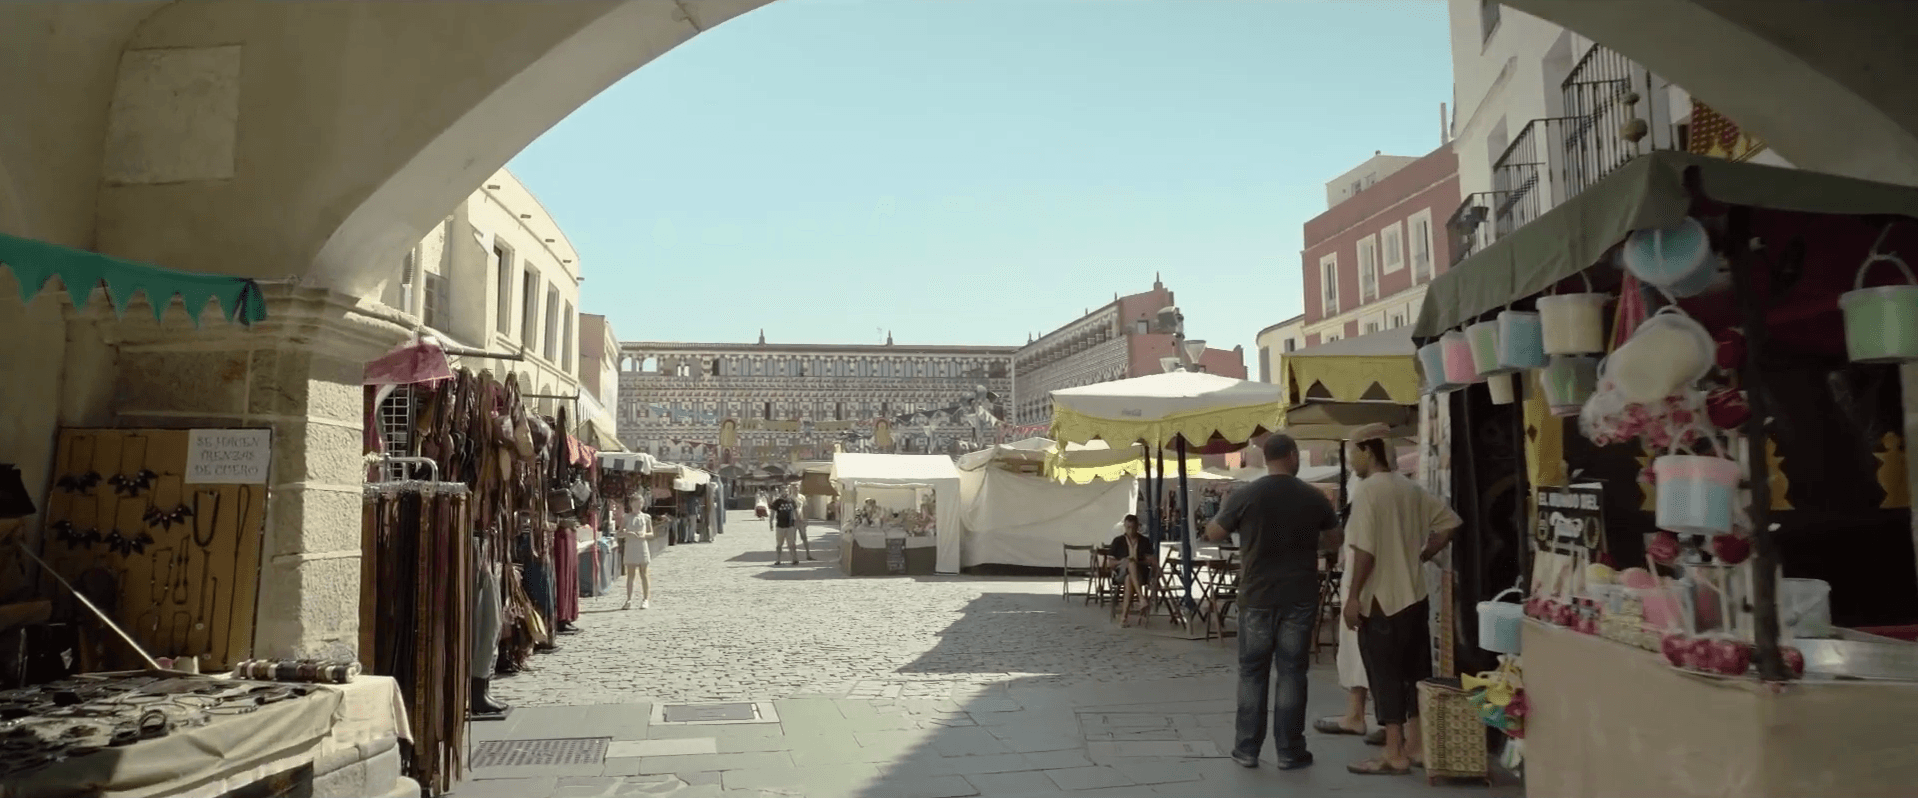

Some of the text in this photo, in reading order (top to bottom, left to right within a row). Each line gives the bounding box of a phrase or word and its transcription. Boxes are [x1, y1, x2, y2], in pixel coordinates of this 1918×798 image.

[197, 436, 258, 448] SE HACEN
[201, 449, 254, 461] TRENZAS
[194, 464, 258, 477] DE CUERO
